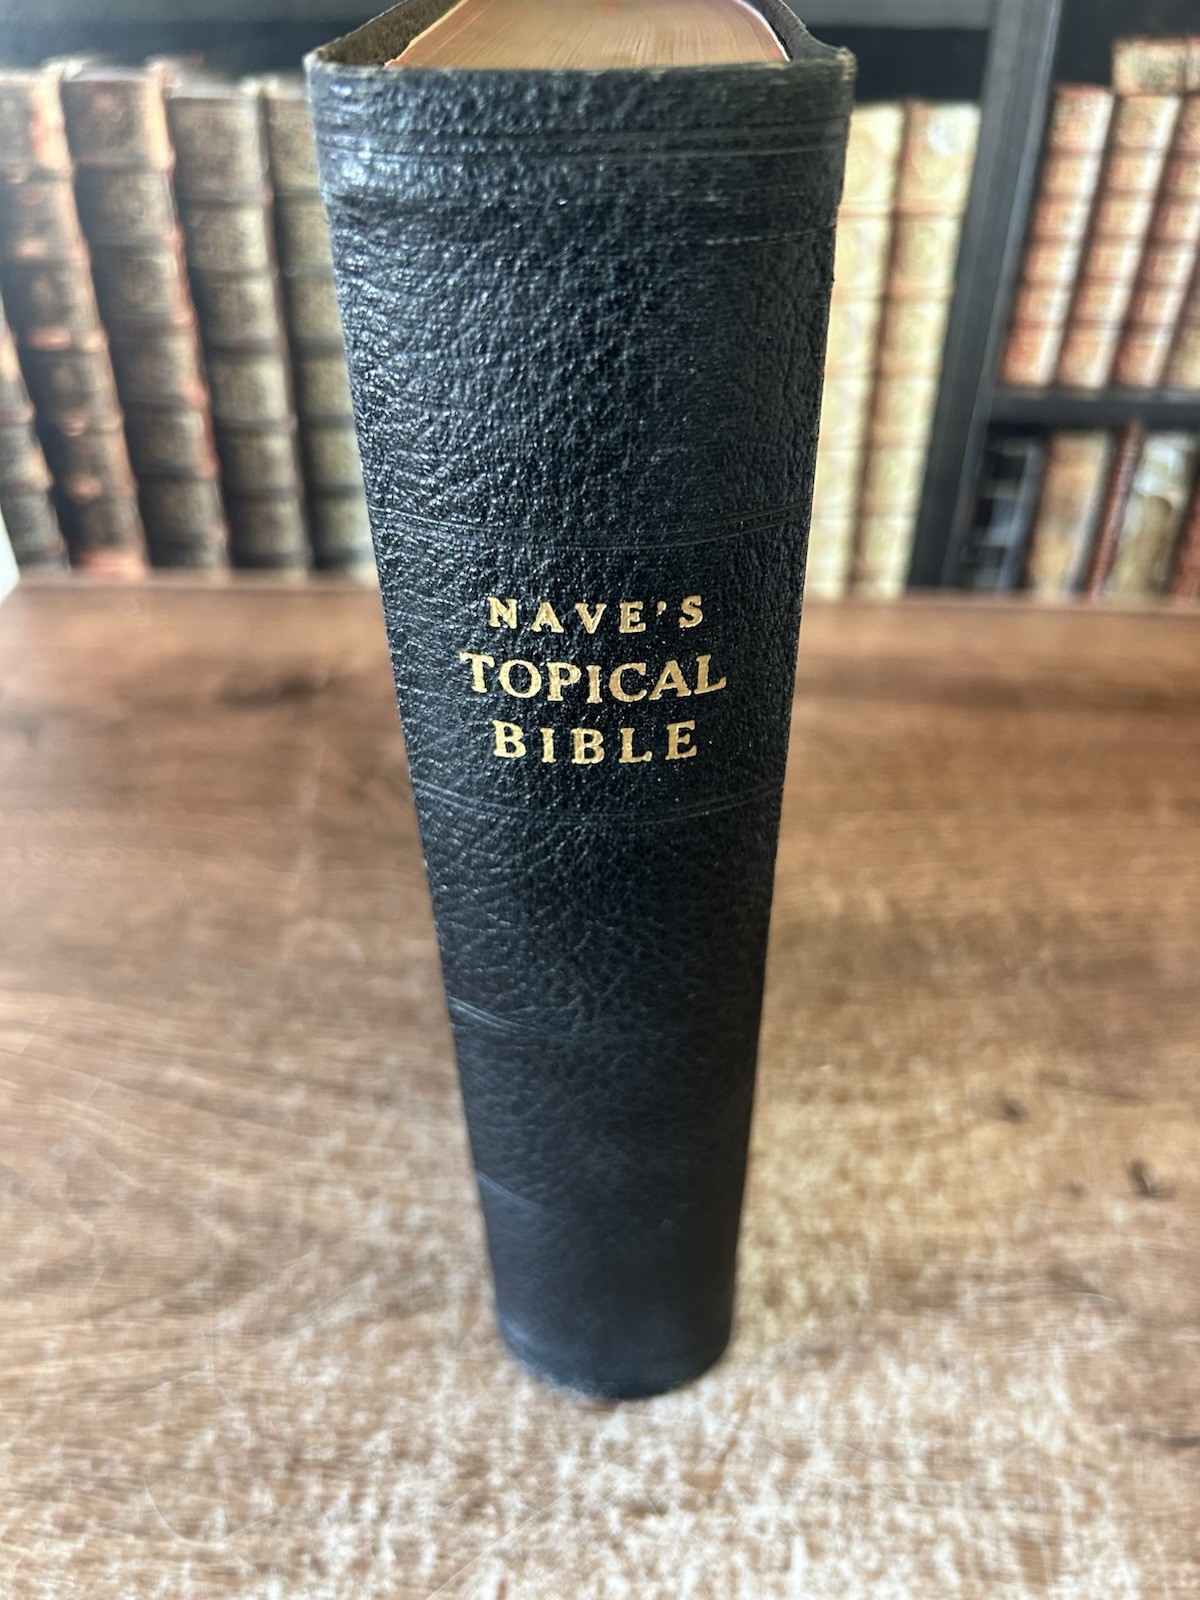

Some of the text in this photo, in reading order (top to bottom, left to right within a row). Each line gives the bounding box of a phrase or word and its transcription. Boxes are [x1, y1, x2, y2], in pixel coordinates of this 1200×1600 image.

[487, 595, 703, 634] NAVE'S
[459, 651, 727, 703] TOPICAL
[492, 719, 698, 765] BIBLE
